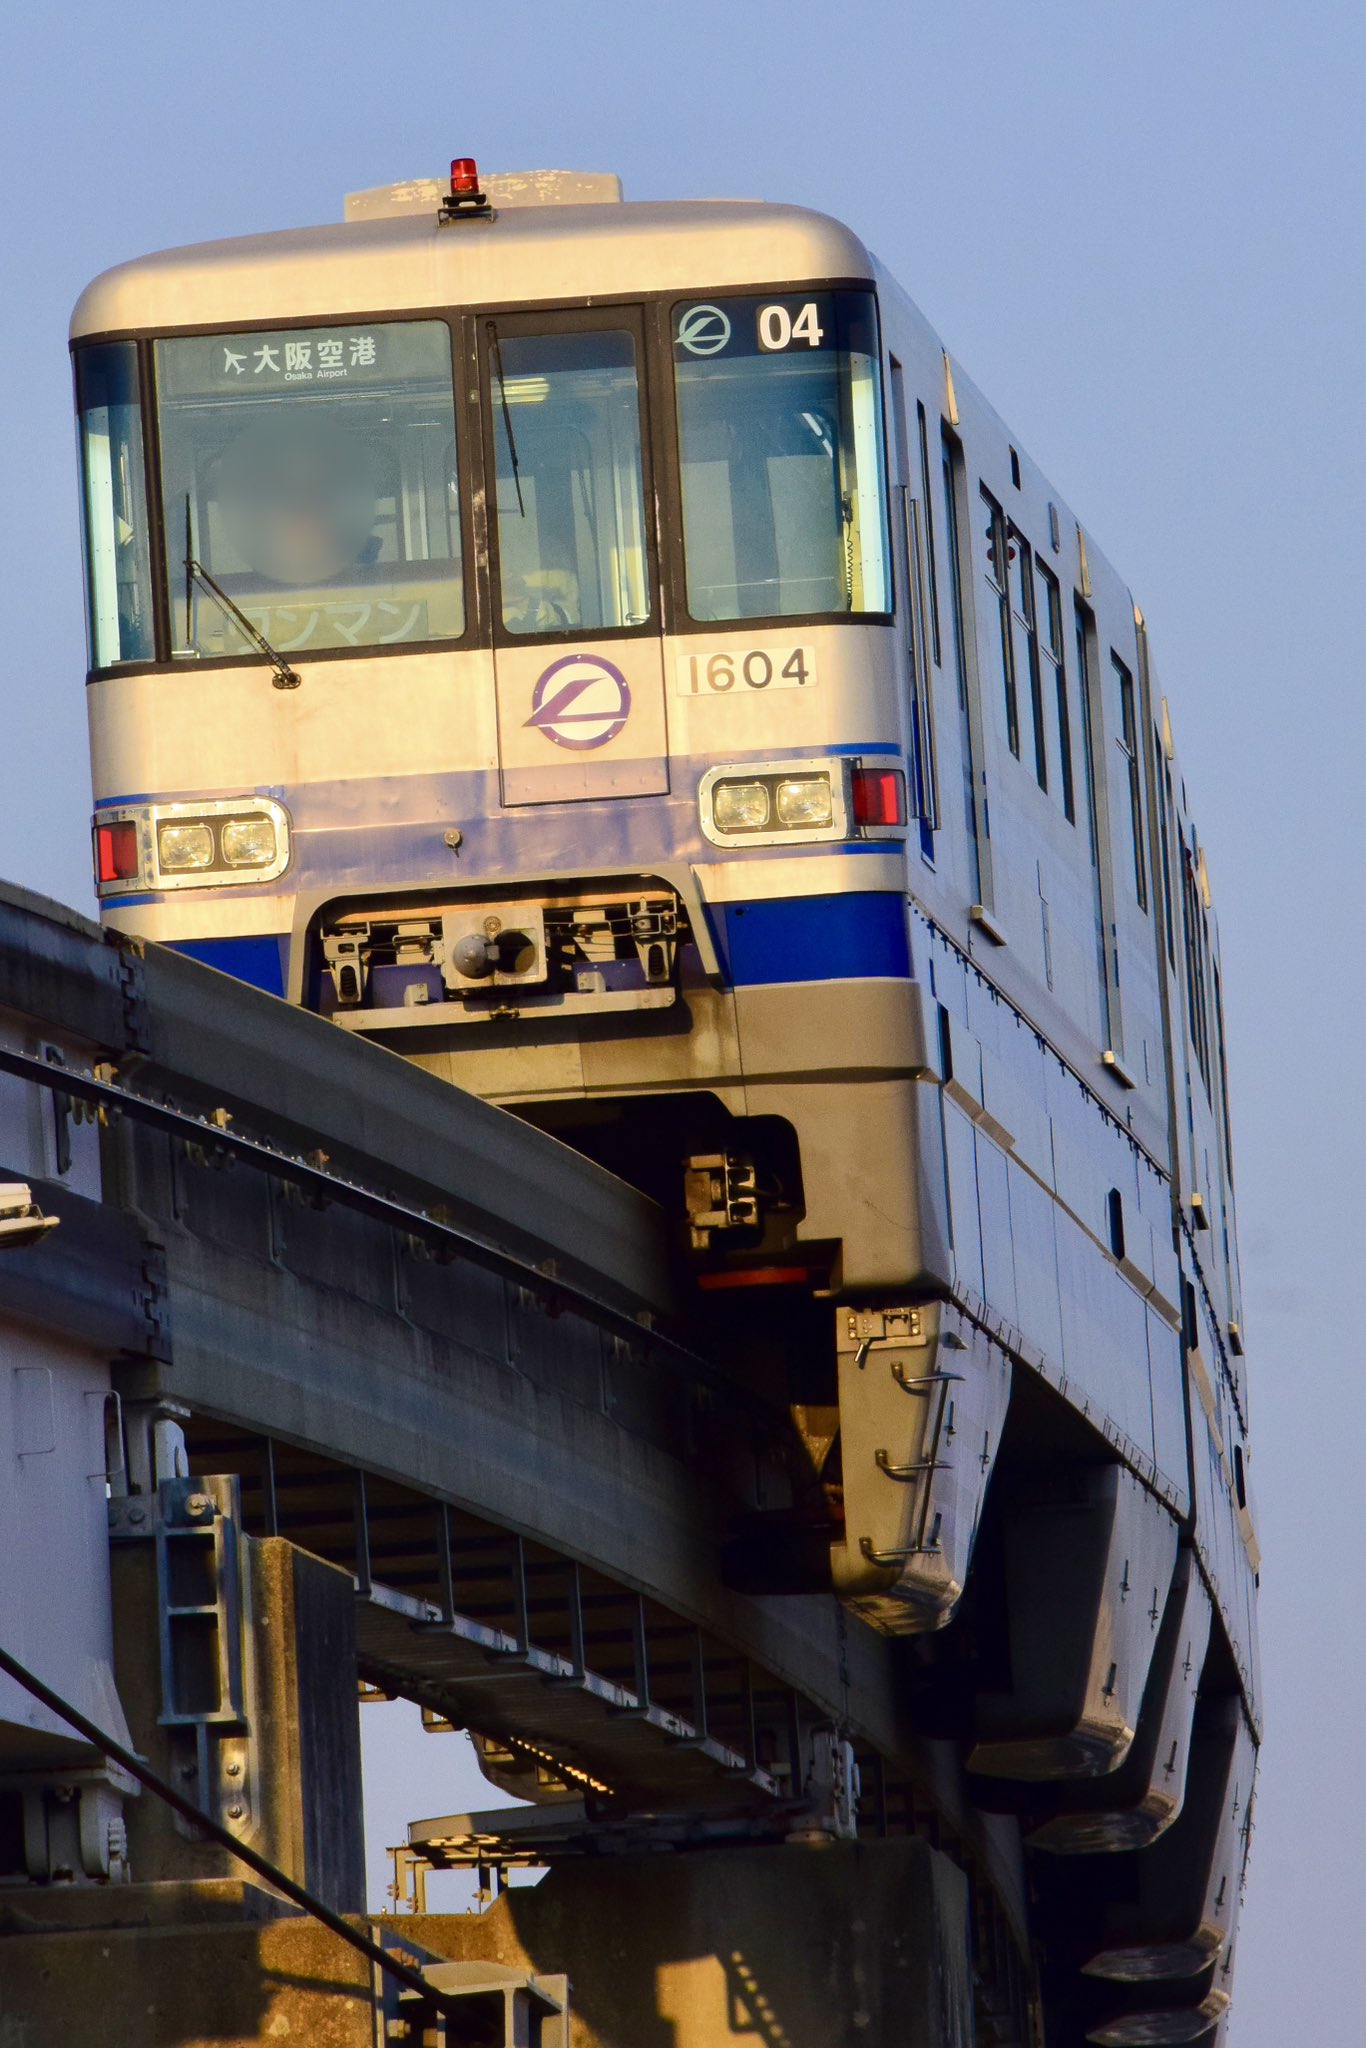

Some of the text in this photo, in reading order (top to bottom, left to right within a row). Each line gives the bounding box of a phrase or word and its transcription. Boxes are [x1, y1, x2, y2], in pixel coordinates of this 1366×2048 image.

[759, 303, 824, 350] 04
[253, 336, 376, 374] 大阪空港
[284, 367, 348, 381] Osaka Airport
[689, 648, 809, 694] 1604
